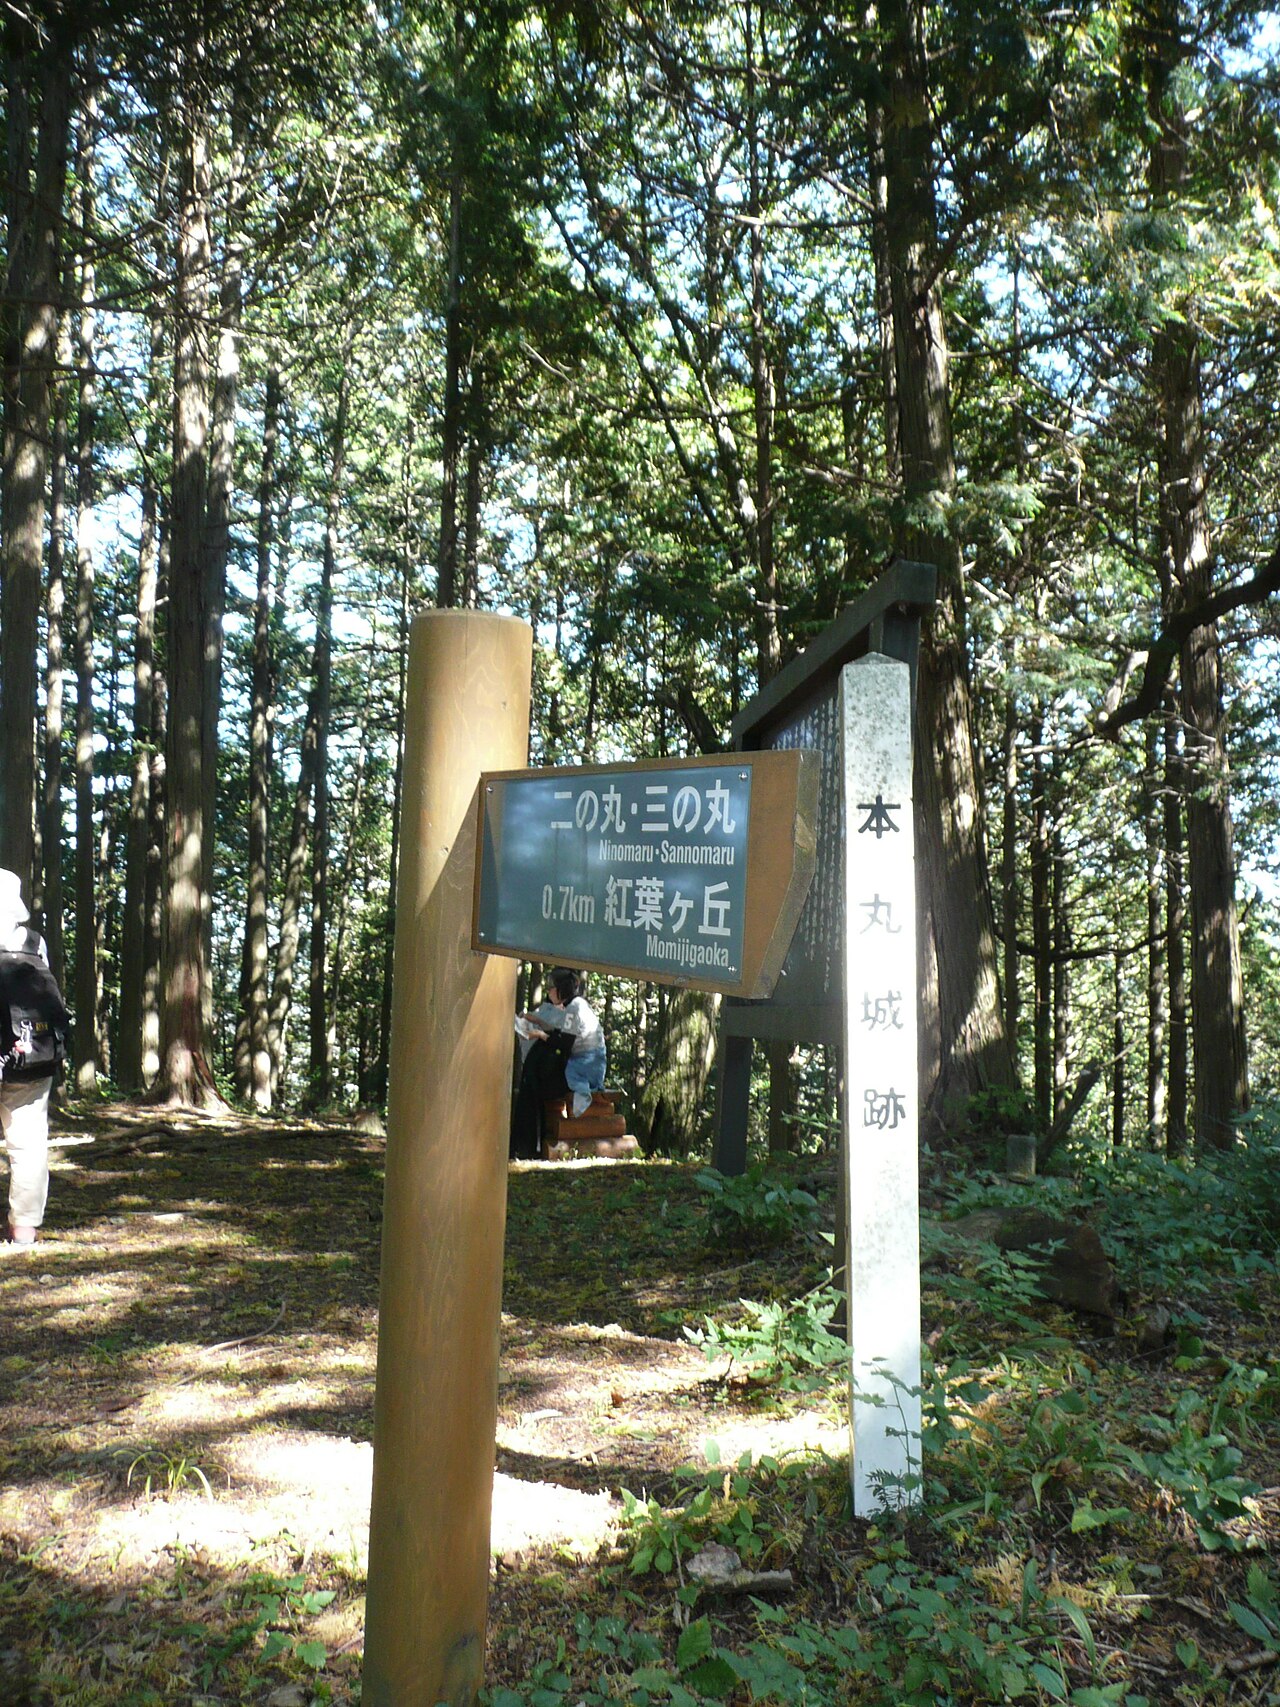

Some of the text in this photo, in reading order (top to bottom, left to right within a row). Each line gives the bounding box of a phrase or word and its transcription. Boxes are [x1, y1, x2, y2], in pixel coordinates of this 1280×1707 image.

[542, 885, 595, 923] 0.7km
[647, 934, 729, 968] Momijigaoka
[856, 795, 906, 1130] 本丸城跡
